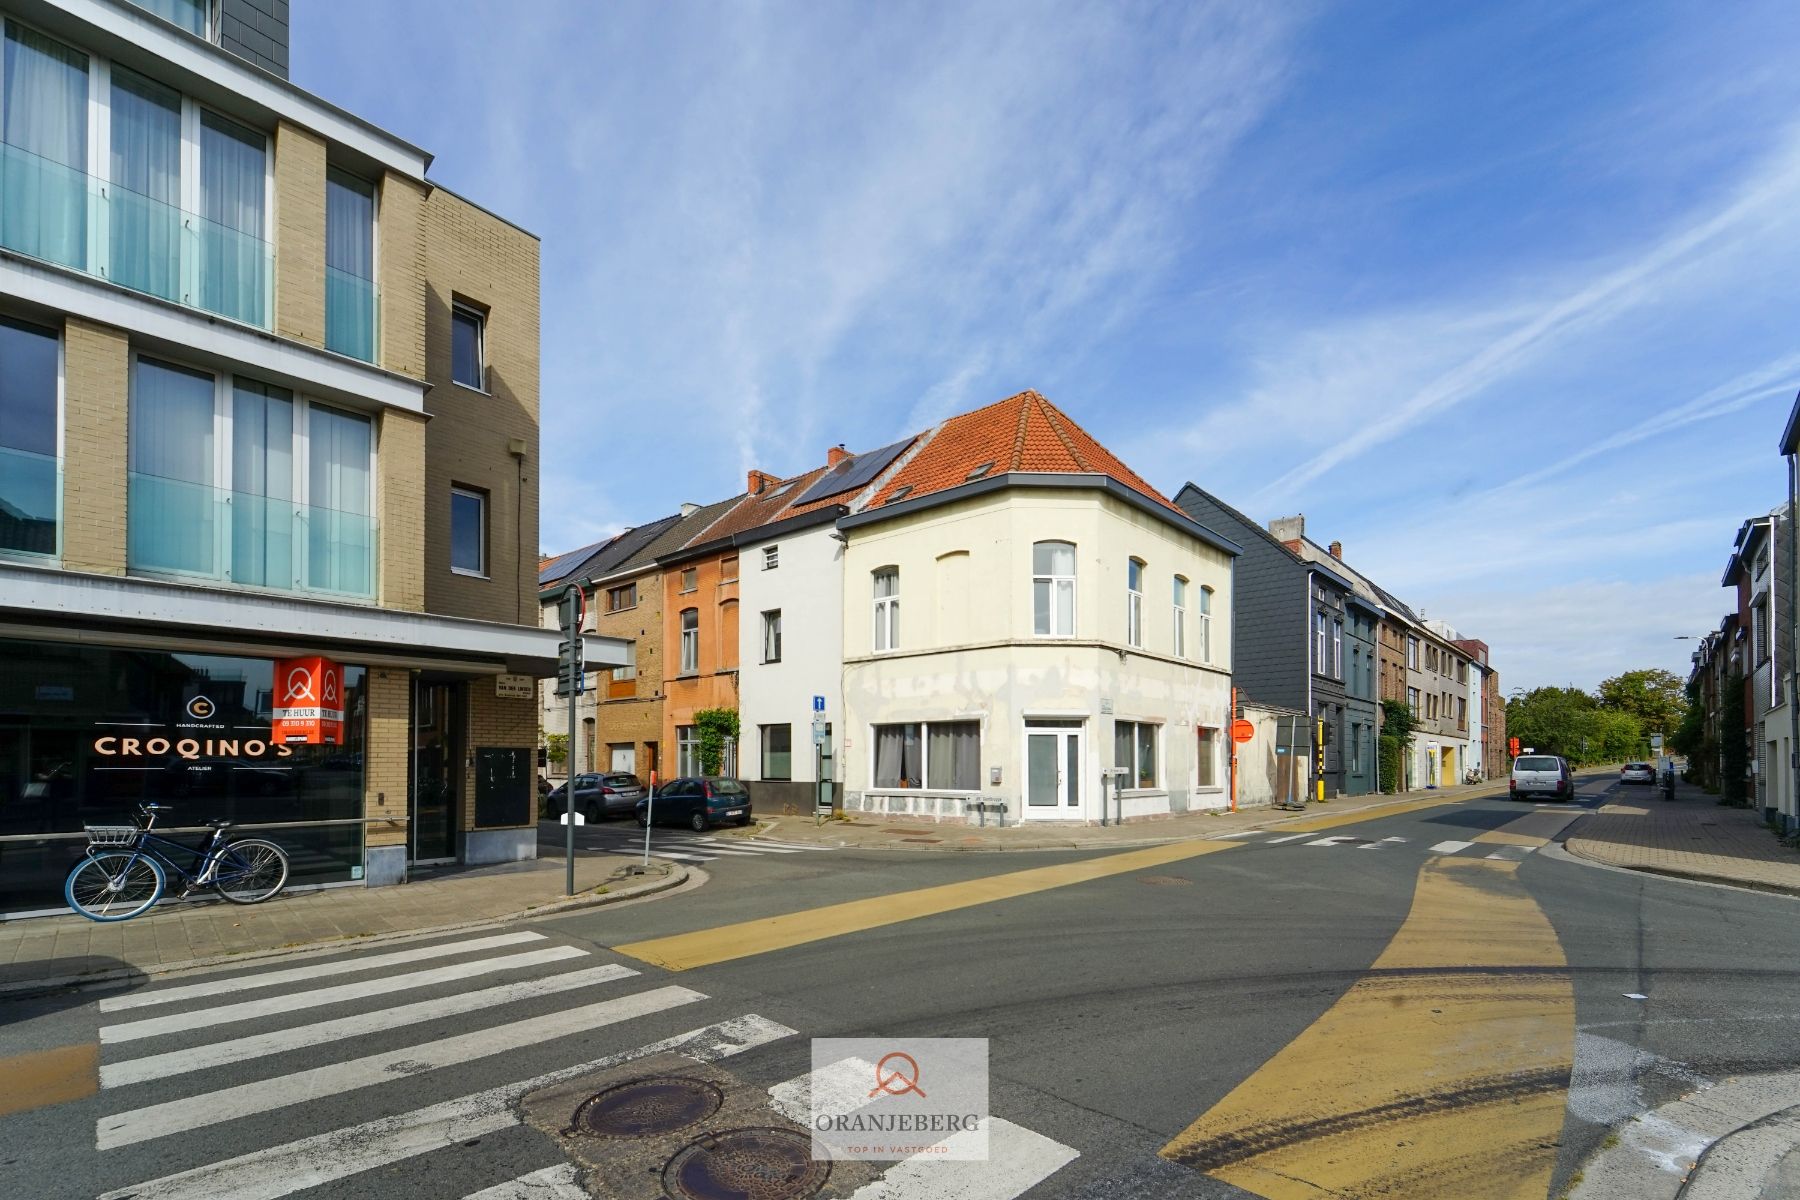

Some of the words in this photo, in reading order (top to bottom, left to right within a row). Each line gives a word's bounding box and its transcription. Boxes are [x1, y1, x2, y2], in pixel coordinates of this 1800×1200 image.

[283, 709, 292, 717] TE
[294, 709, 315, 717] HUUR
[94, 736, 293, 760] CROQINO'S
